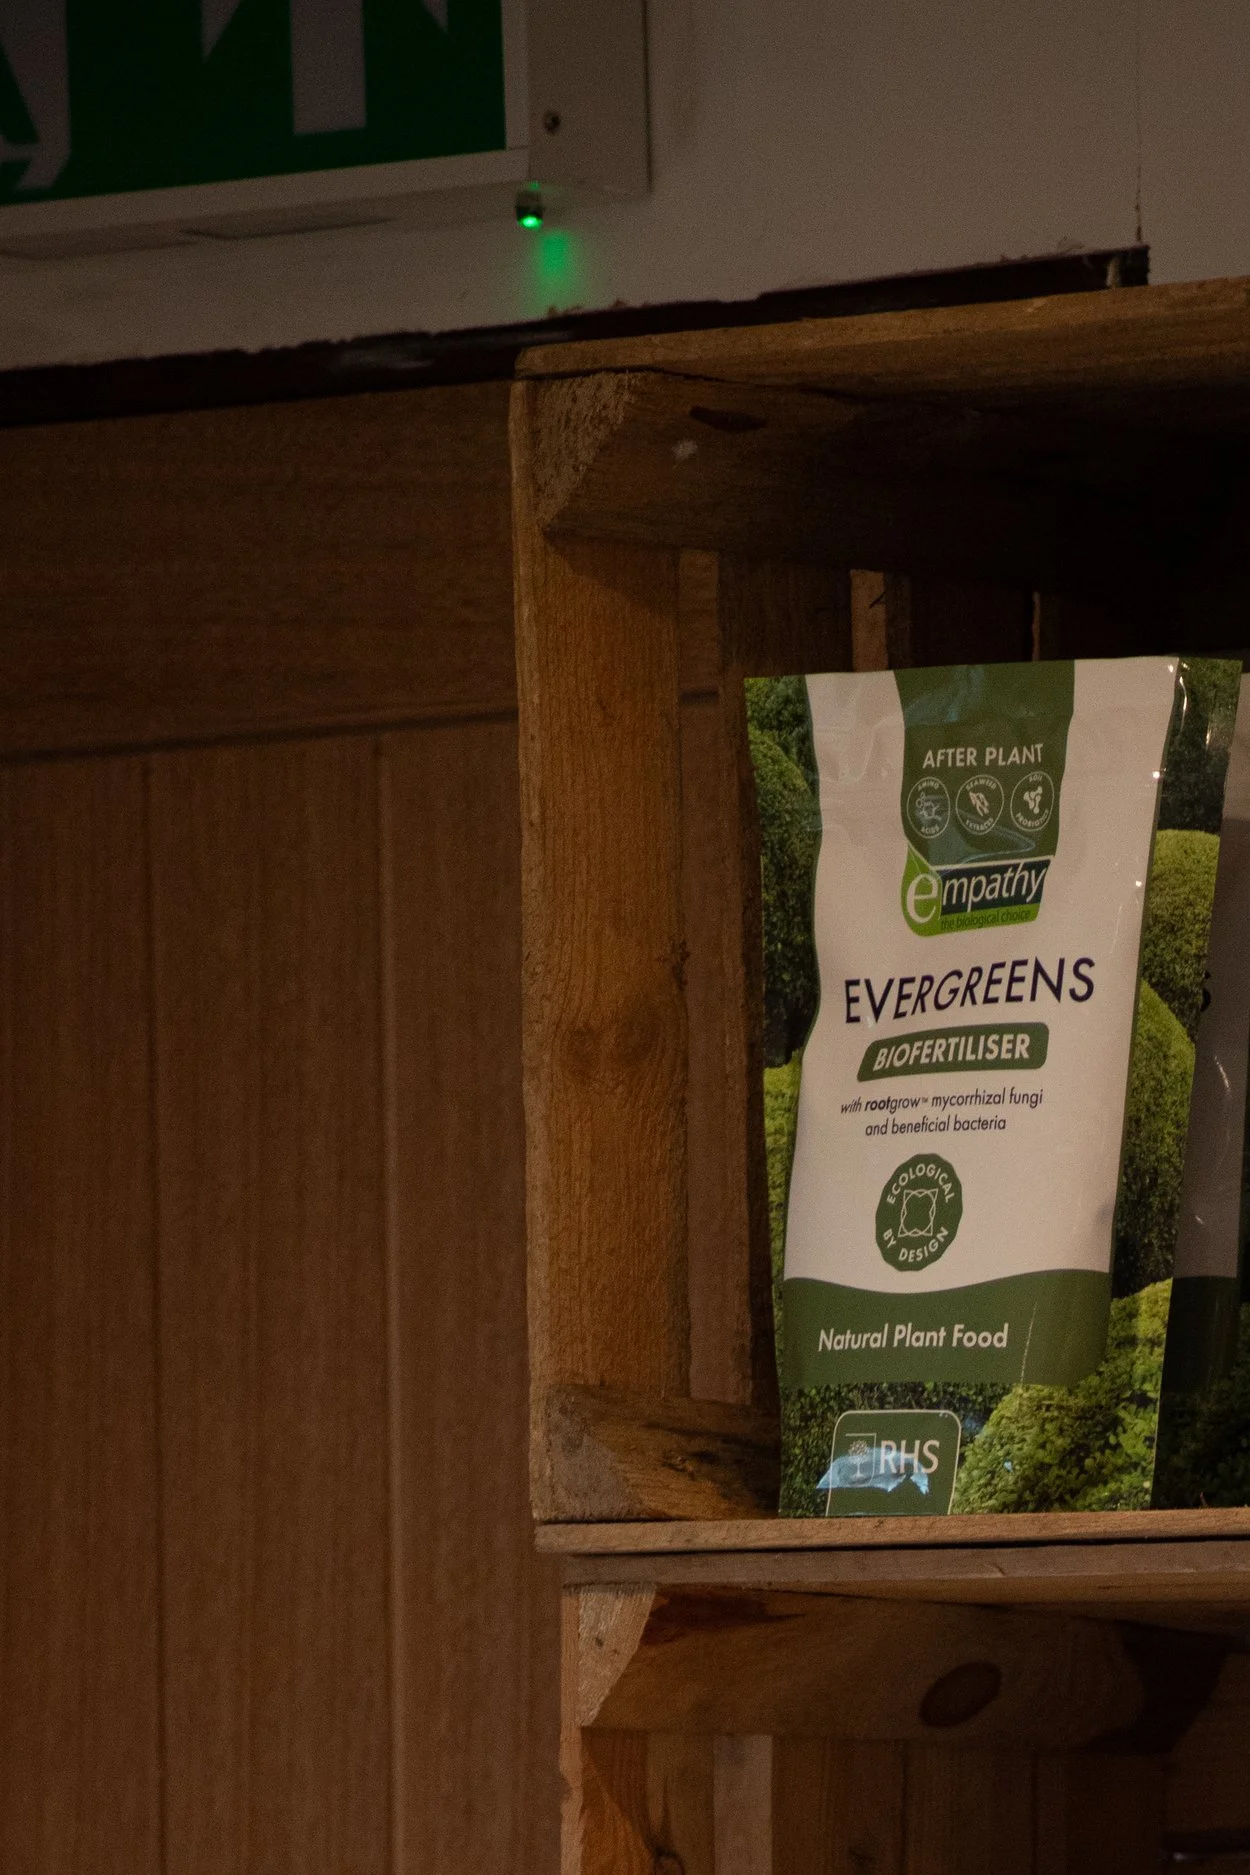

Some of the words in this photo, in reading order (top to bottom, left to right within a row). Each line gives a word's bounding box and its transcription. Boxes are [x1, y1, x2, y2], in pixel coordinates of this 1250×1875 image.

[922, 747, 978, 769] AFTER
[984, 743, 1045, 767] PLANT
[906, 861, 1048, 924] empathy
[940, 916, 954, 931] the
[956, 909, 999, 929] biological
[1000, 907, 1032, 922] choice
[843, 956, 1096, 1025] EVERGREENS
[872, 1032, 1031, 1072] BIOFERTILISER
[840, 1098, 863, 1115] with
[931, 1088, 1006, 1112] mycorrhizal
[1008, 1088, 1044, 1111] fungi
[864, 1118, 888, 1138] and
[890, 1116, 951, 1136] beneficial
[953, 1115, 1007, 1133] bacteria
[886, 1163, 957, 1206] ECOLOGICAL
[881, 1227, 897, 1250] BY
[898, 1225, 949, 1264] DESIGN
[817, 1322, 888, 1353] Natural
[893, 1321, 947, 1350] Plant
[952, 1322, 1009, 1350] Food
[879, 1438, 941, 1475] RHS
